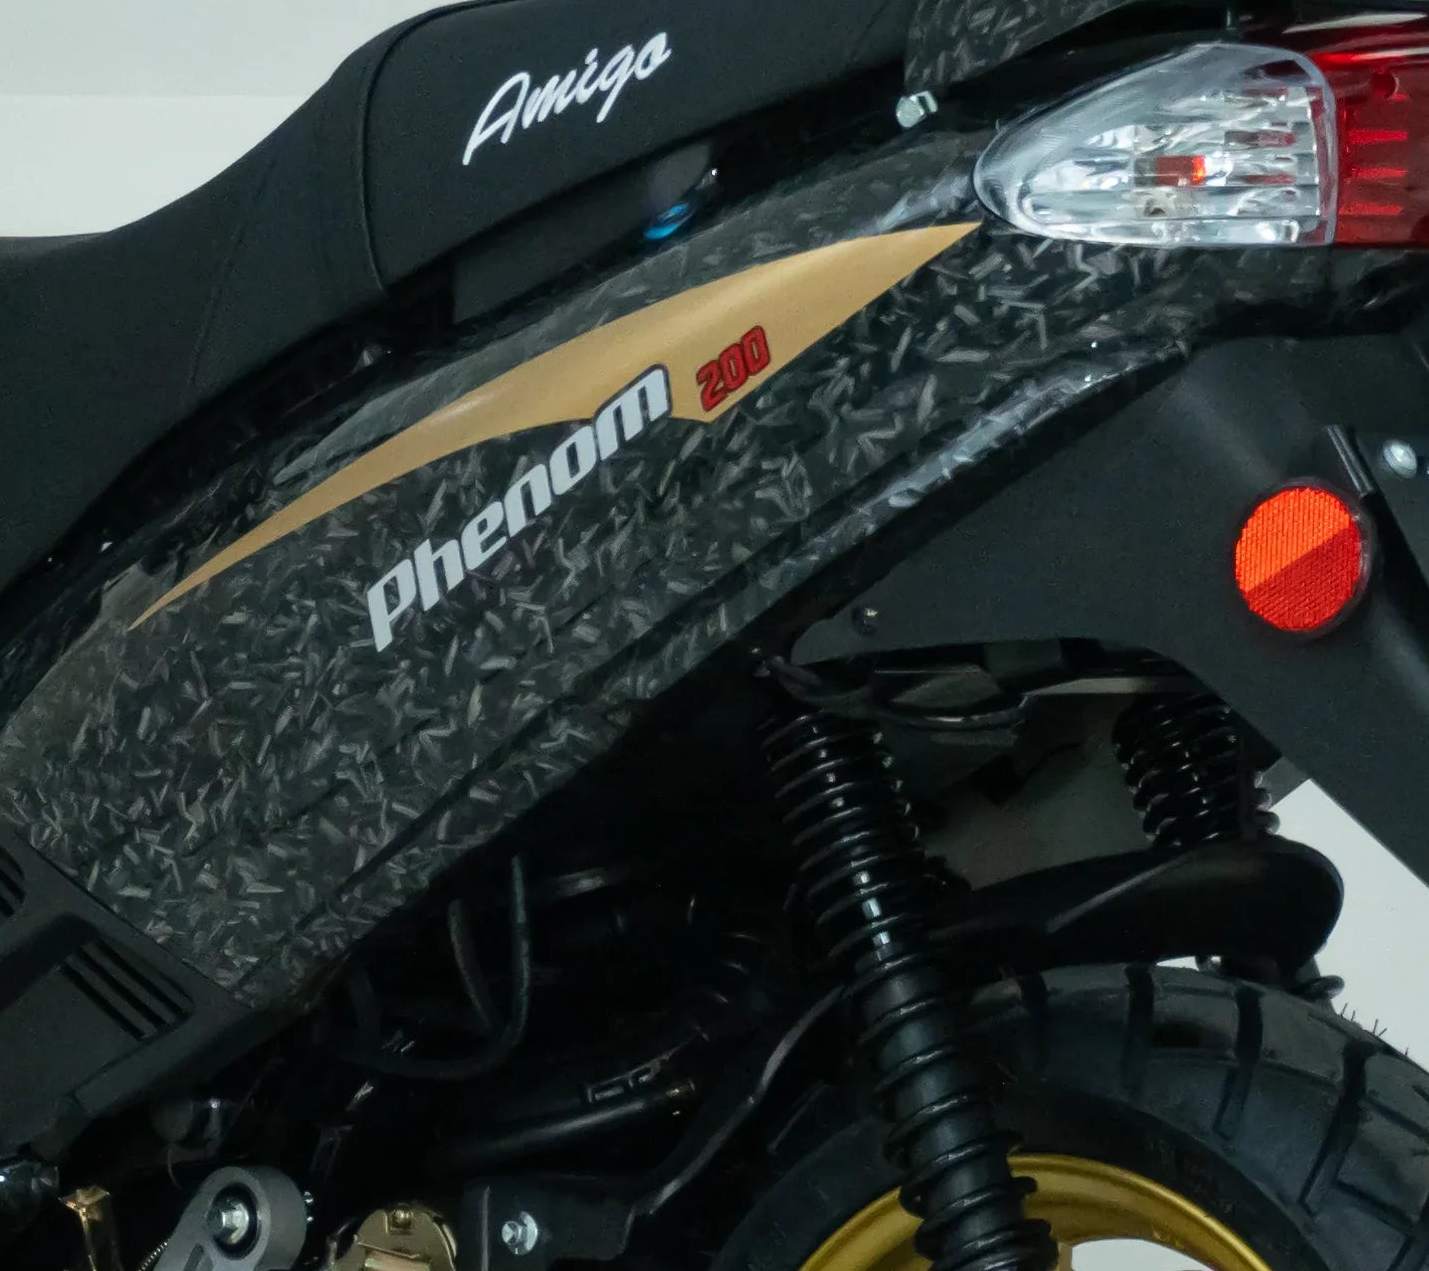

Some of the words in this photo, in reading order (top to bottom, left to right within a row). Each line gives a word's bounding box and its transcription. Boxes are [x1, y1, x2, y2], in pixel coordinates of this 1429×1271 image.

[462, 31, 672, 166] Amigo
[365, 365, 670, 653] Phenom
[695, 324, 772, 413] 200
